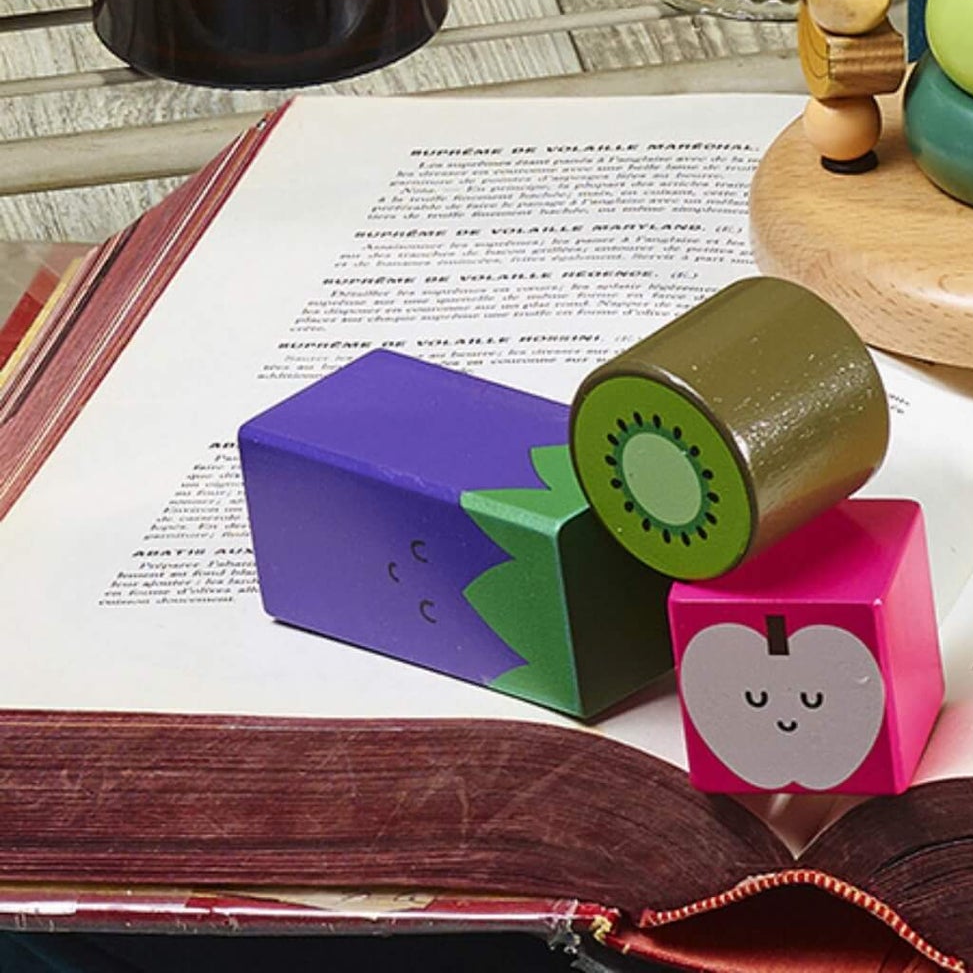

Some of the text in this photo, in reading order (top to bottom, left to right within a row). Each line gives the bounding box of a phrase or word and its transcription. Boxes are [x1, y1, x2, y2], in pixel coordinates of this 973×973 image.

[410, 141, 757, 156] SUPRÊME DE VOLAILLE MARÉCHAL.
[354, 229, 446, 238] SUPRÊME
[491, 225, 582, 234] VOLAILLE
[591, 223, 705, 233] MARYLAND.
[322, 276, 414, 285] SUPRÊME
[424, 275, 449, 283] DE
[459, 272, 550, 281] VOLAILLE
[560, 269, 657, 279] RÉGENCE.
[277, 334, 600, 349] SUPRÊME DE VOLAILLE ROSSINI.
[132, 548, 205, 557] ABATIS
